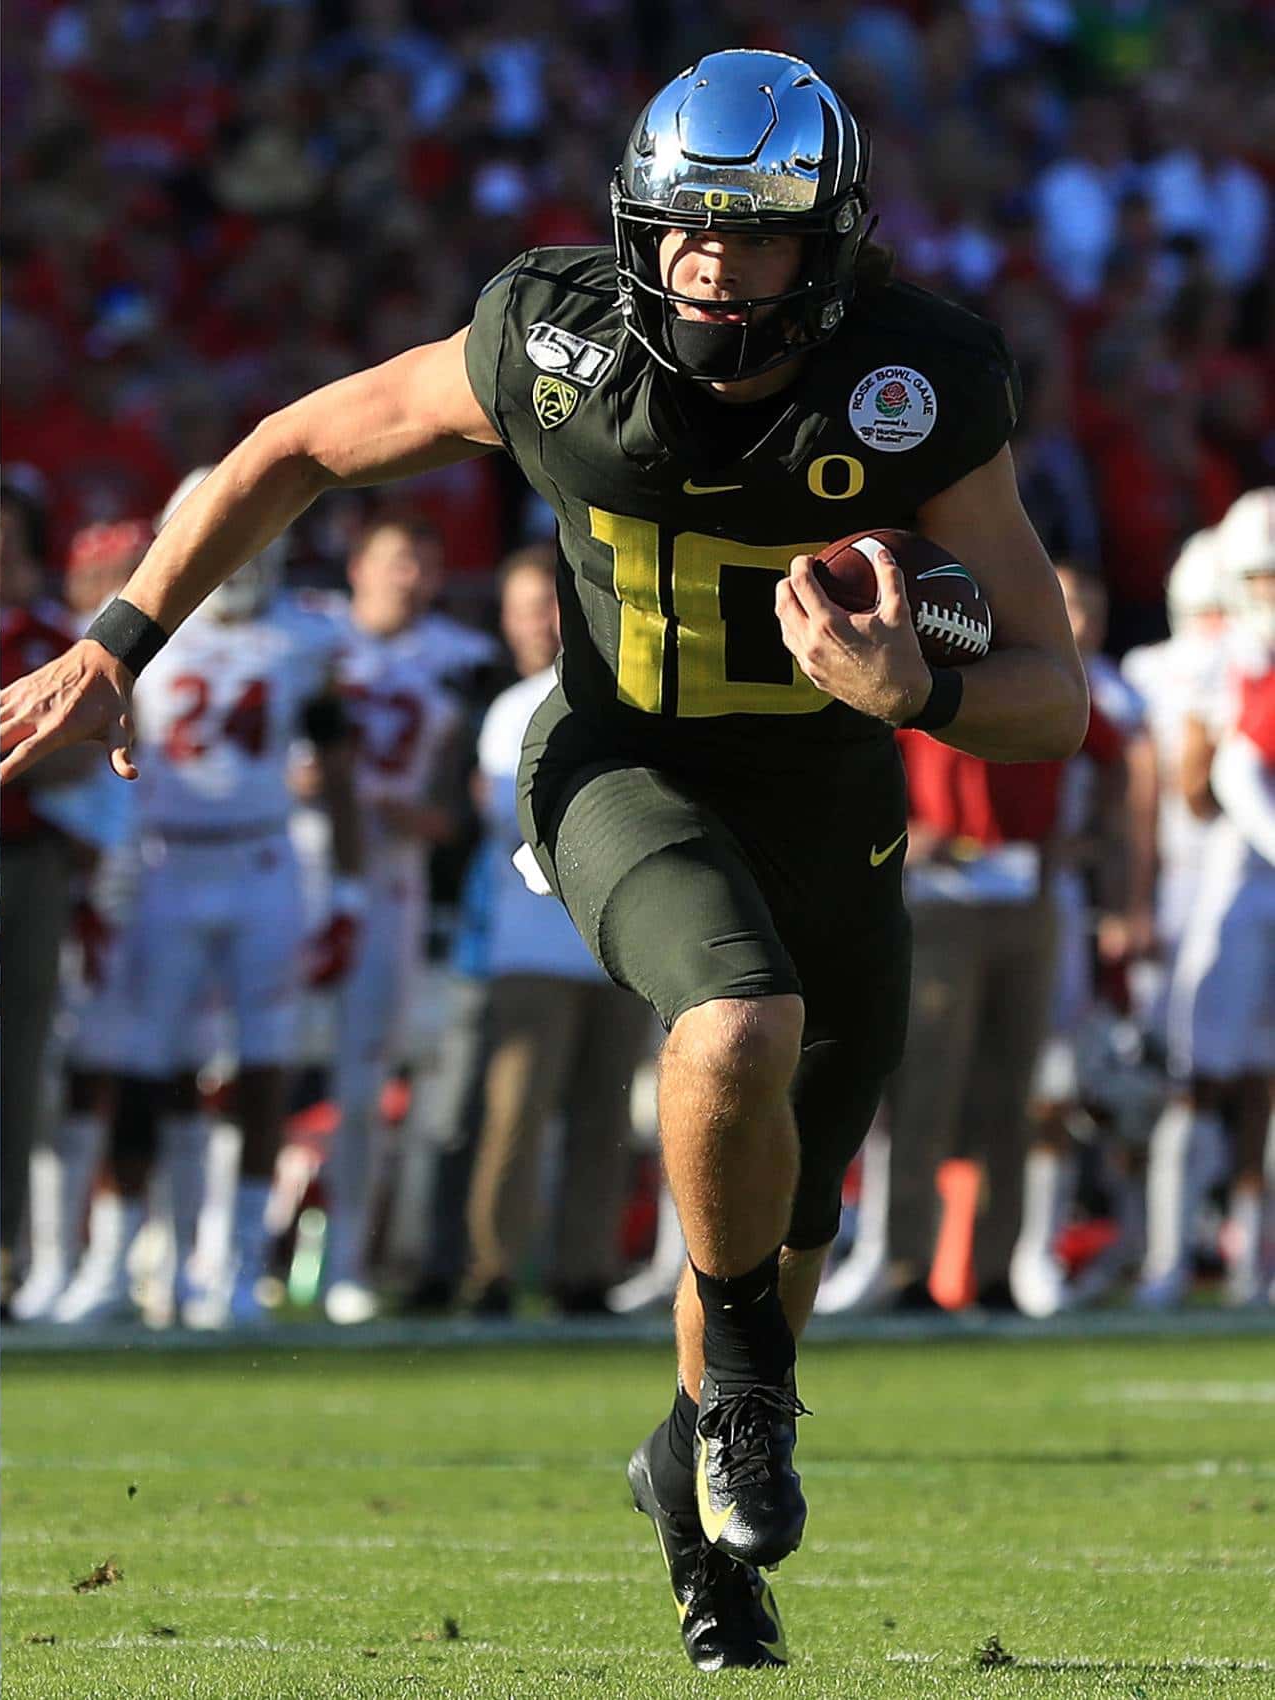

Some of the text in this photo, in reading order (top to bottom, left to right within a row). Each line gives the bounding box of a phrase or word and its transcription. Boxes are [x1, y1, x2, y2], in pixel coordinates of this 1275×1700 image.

[704, 188, 729, 211] O
[852, 368, 934, 416] ROSE BOWL GAME
[807, 454, 865, 500] O
[589, 506, 833, 718] 10
[164, 672, 270, 766] 24
